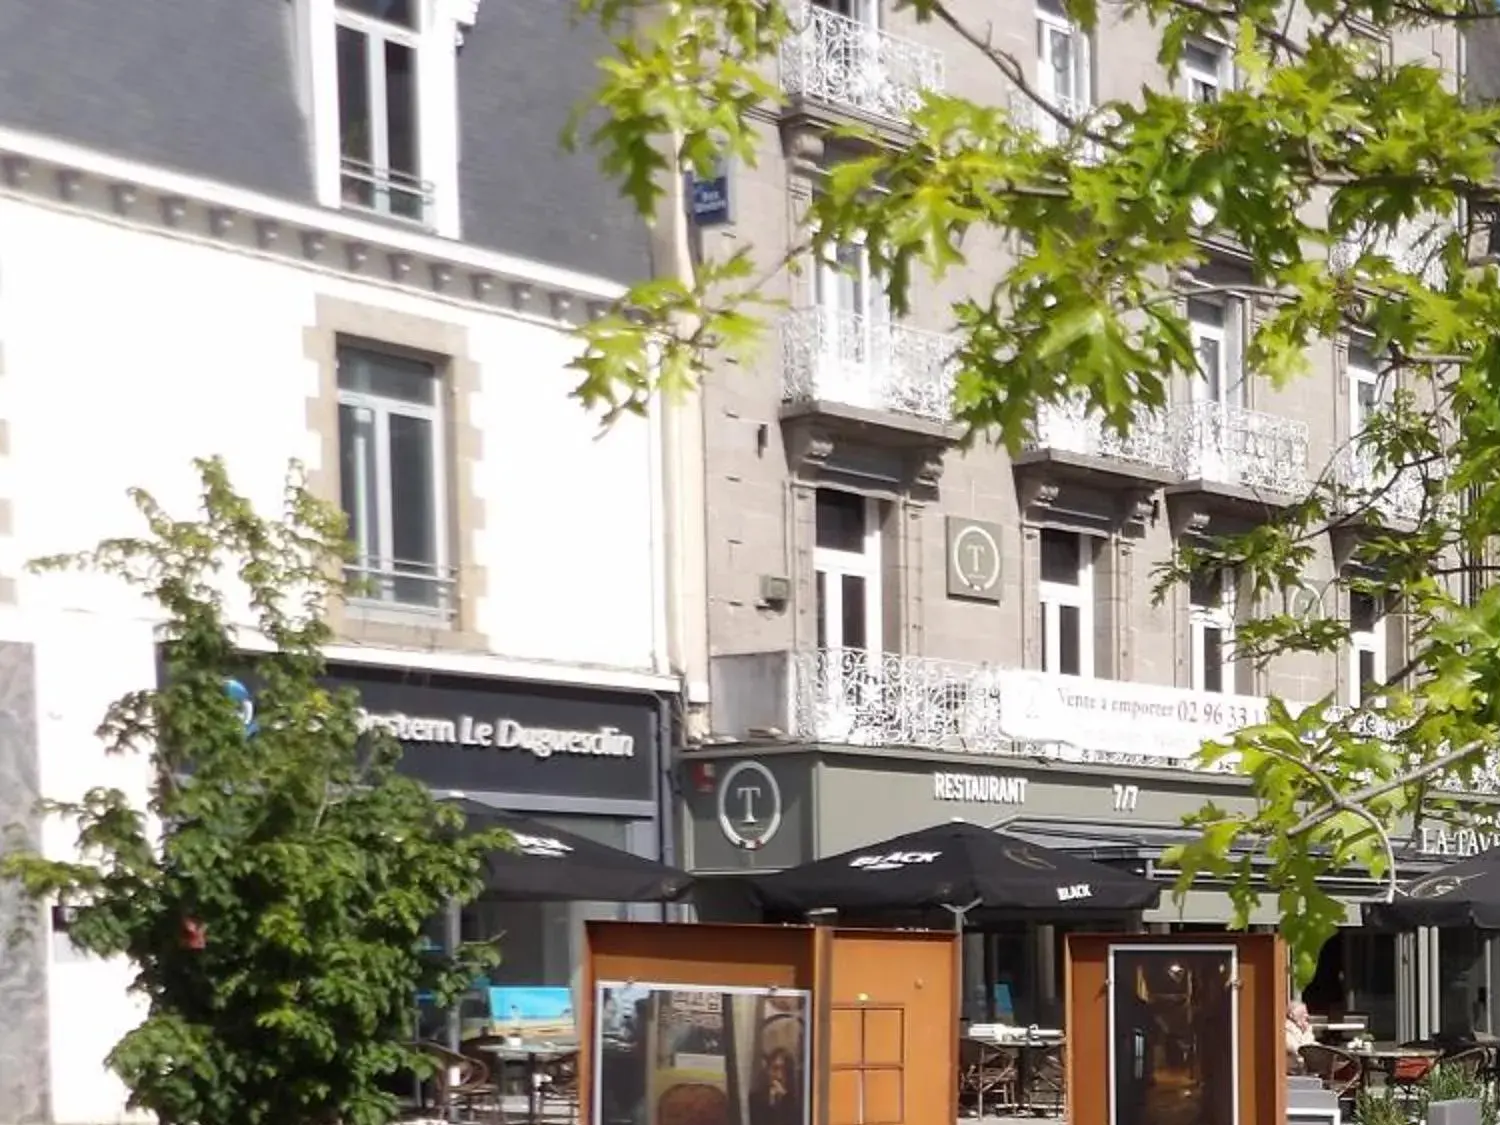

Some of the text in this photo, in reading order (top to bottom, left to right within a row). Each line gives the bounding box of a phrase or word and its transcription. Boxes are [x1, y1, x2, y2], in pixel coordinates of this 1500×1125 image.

[1057, 687, 1096, 711] Vente
[1111, 699, 1175, 721] emporter
[1177, 699, 1198, 724] 02
[1203, 702, 1223, 726] 96
[1227, 705, 1248, 729] 33
[459, 715, 493, 745] Le
[498, 719, 635, 757] Duguesclin
[935, 772, 1028, 803] RESTAURANT
[1113, 784, 1138, 809] 7/7
[737, 787, 761, 823] T
[1419, 826, 1449, 855] LA
[1057, 884, 1092, 900] BLACK
